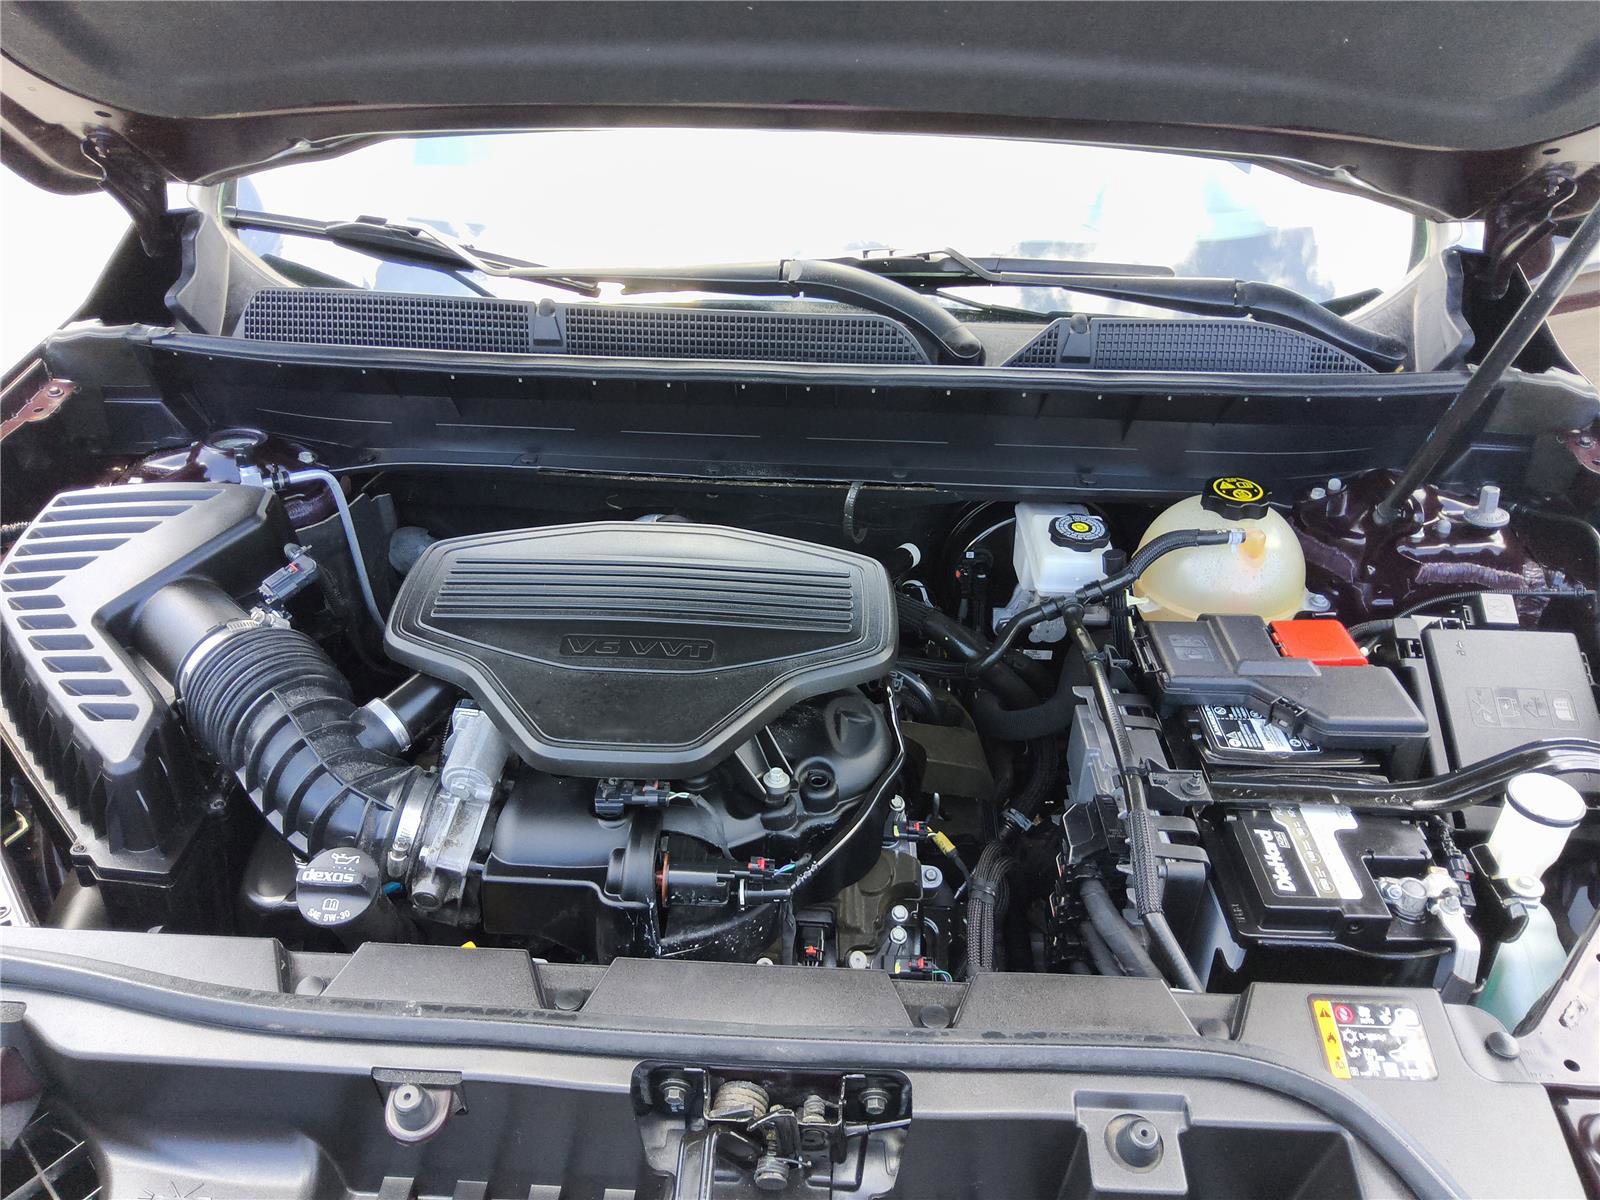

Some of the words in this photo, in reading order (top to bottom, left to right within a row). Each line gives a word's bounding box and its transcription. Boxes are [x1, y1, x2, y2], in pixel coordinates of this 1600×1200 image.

[567, 638, 621, 654] V6
[629, 640, 709, 658] VVT
[1253, 828, 1297, 892] DieHard
[302, 868, 355, 883] dexos
[323, 910, 351, 922] 5W-30
